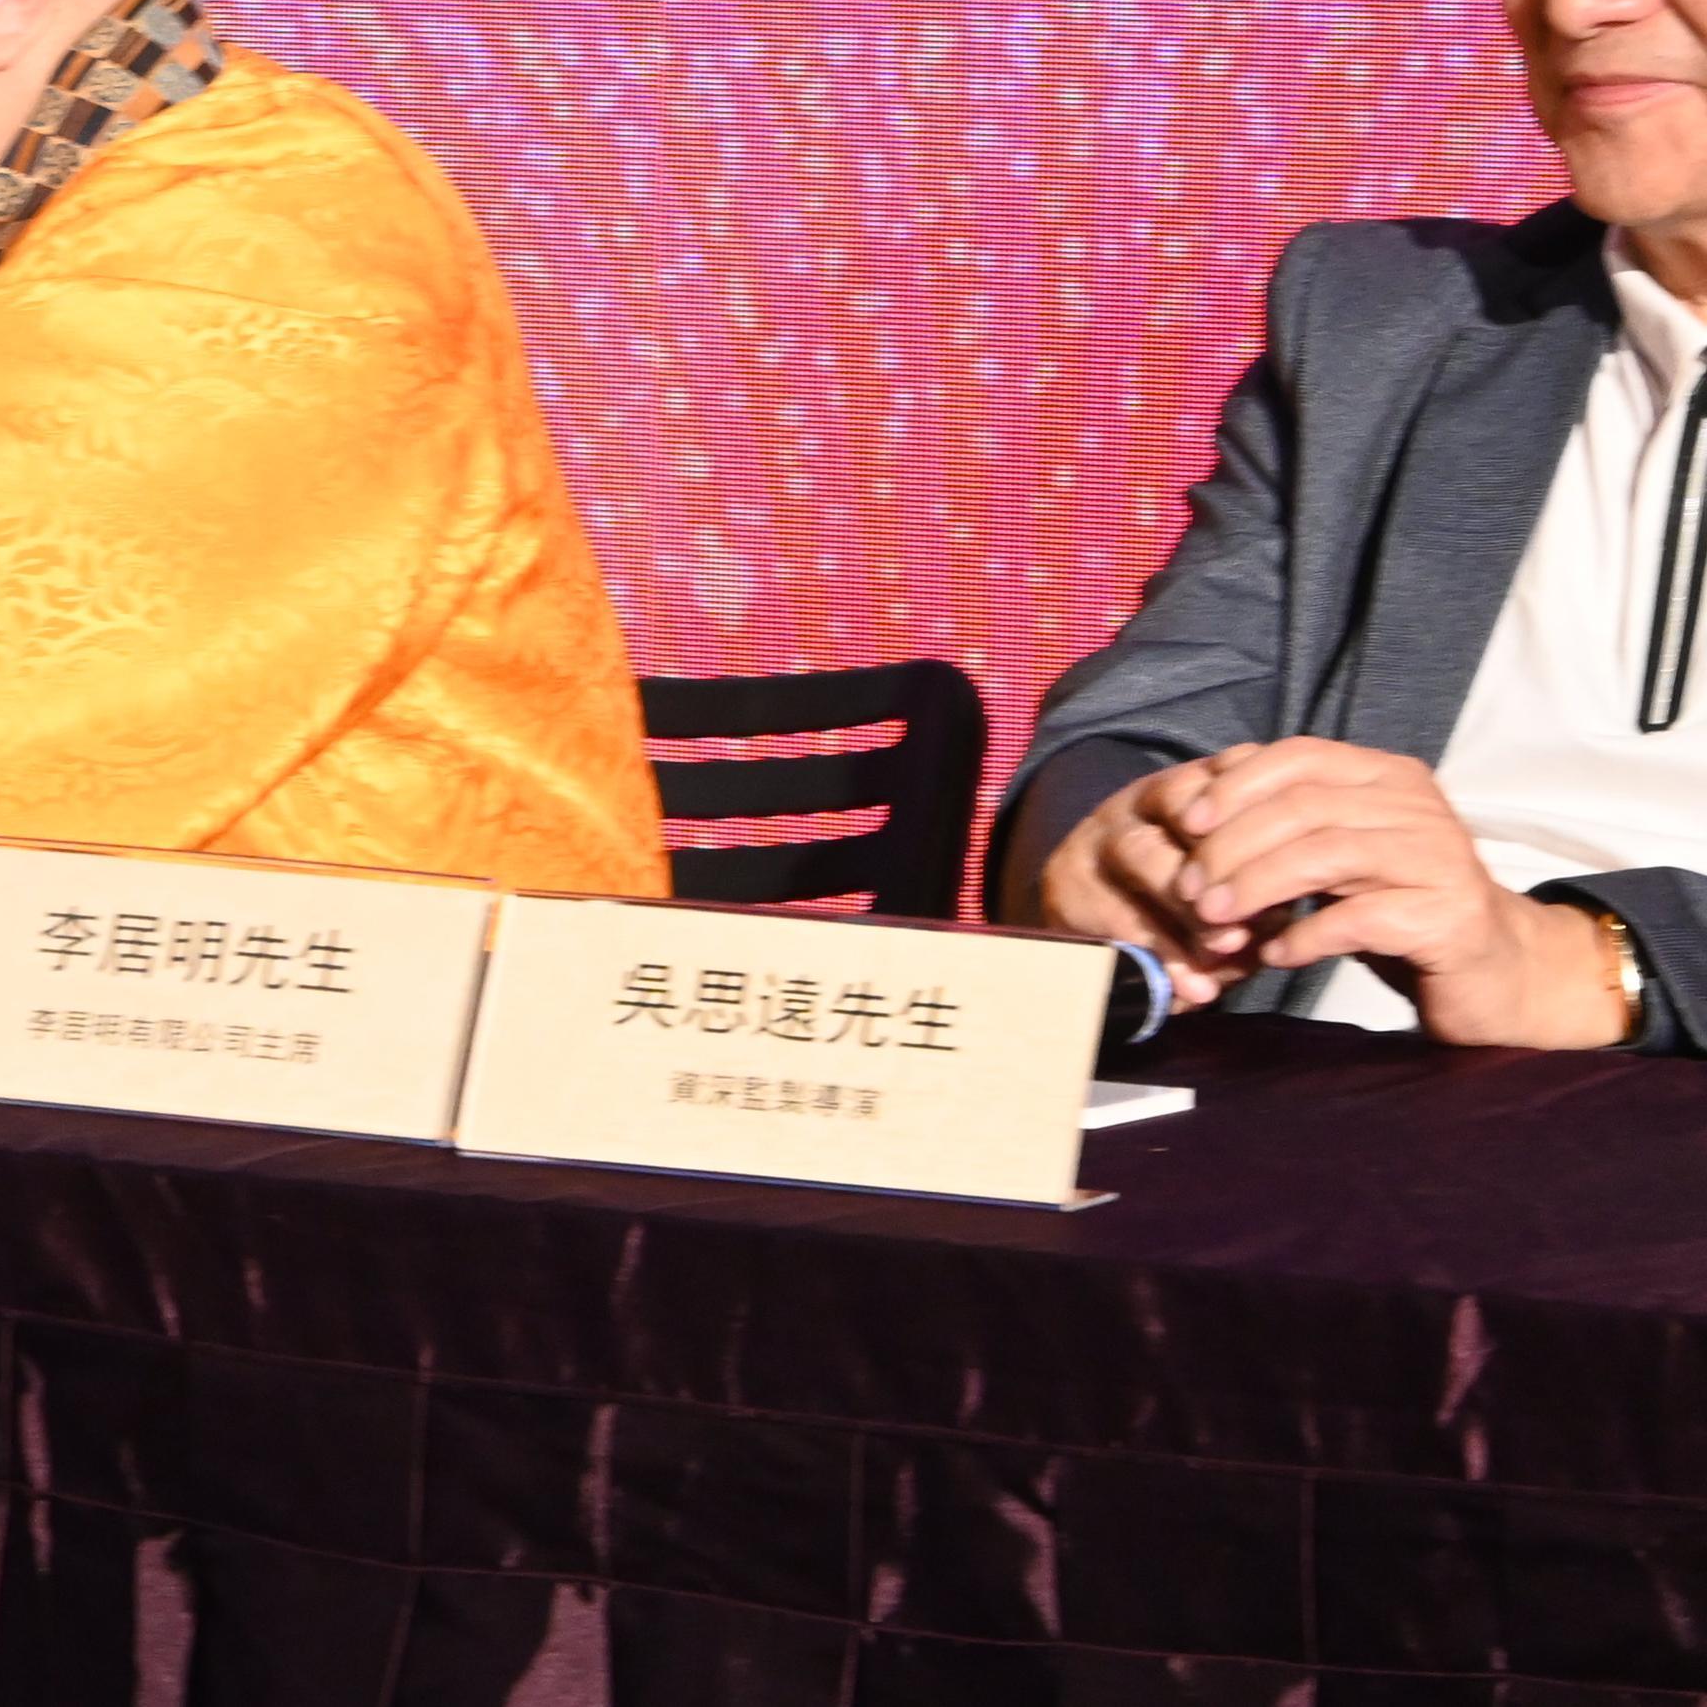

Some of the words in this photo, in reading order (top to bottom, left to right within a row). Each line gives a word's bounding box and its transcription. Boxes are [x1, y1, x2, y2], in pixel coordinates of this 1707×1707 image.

[38, 906, 354, 993] 李居明先生
[26, 1008, 322, 1064] 李居明有限公司主席
[612, 963, 961, 1051] 吳思遠先生
